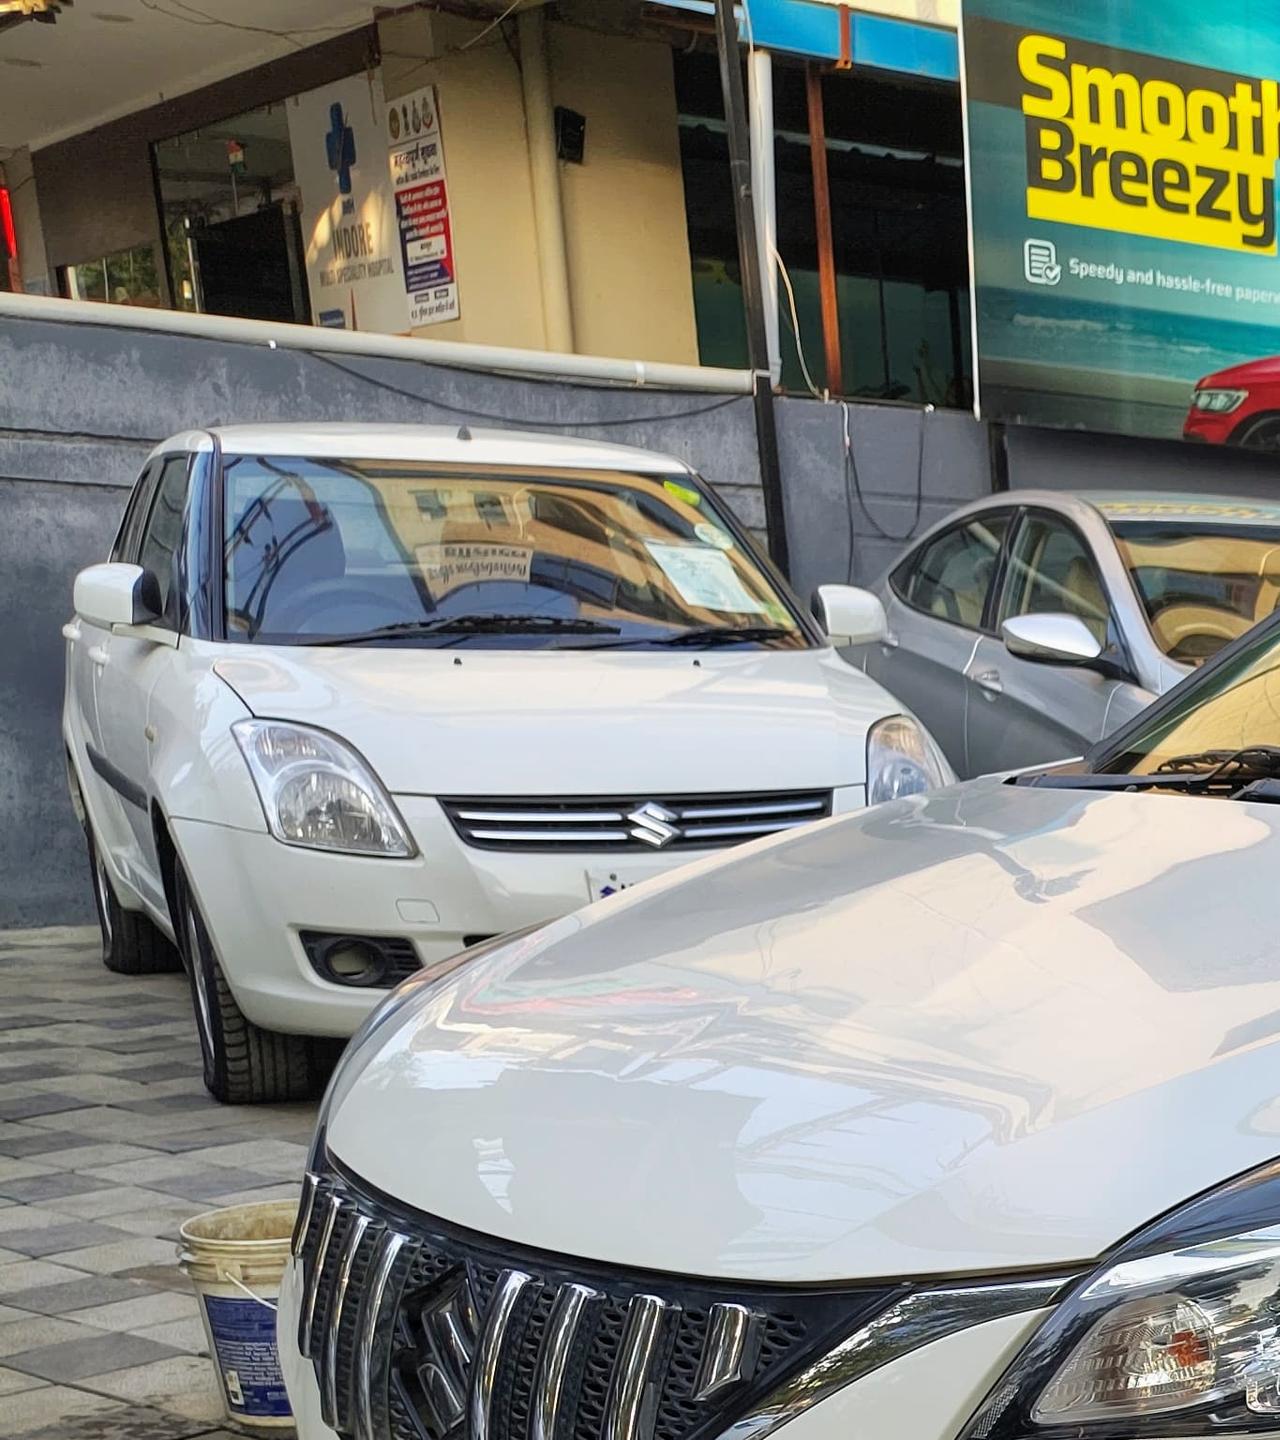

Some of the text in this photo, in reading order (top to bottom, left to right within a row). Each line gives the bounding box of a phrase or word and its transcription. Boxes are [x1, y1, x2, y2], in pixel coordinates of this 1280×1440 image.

[1025, 116, 1276, 248] Breezy
[332, 222, 374, 261] INDORE
[1069, 257, 1124, 285] Speedy
[1126, 269, 1154, 286] and
[1156, 269, 1233, 298] hassle-free
